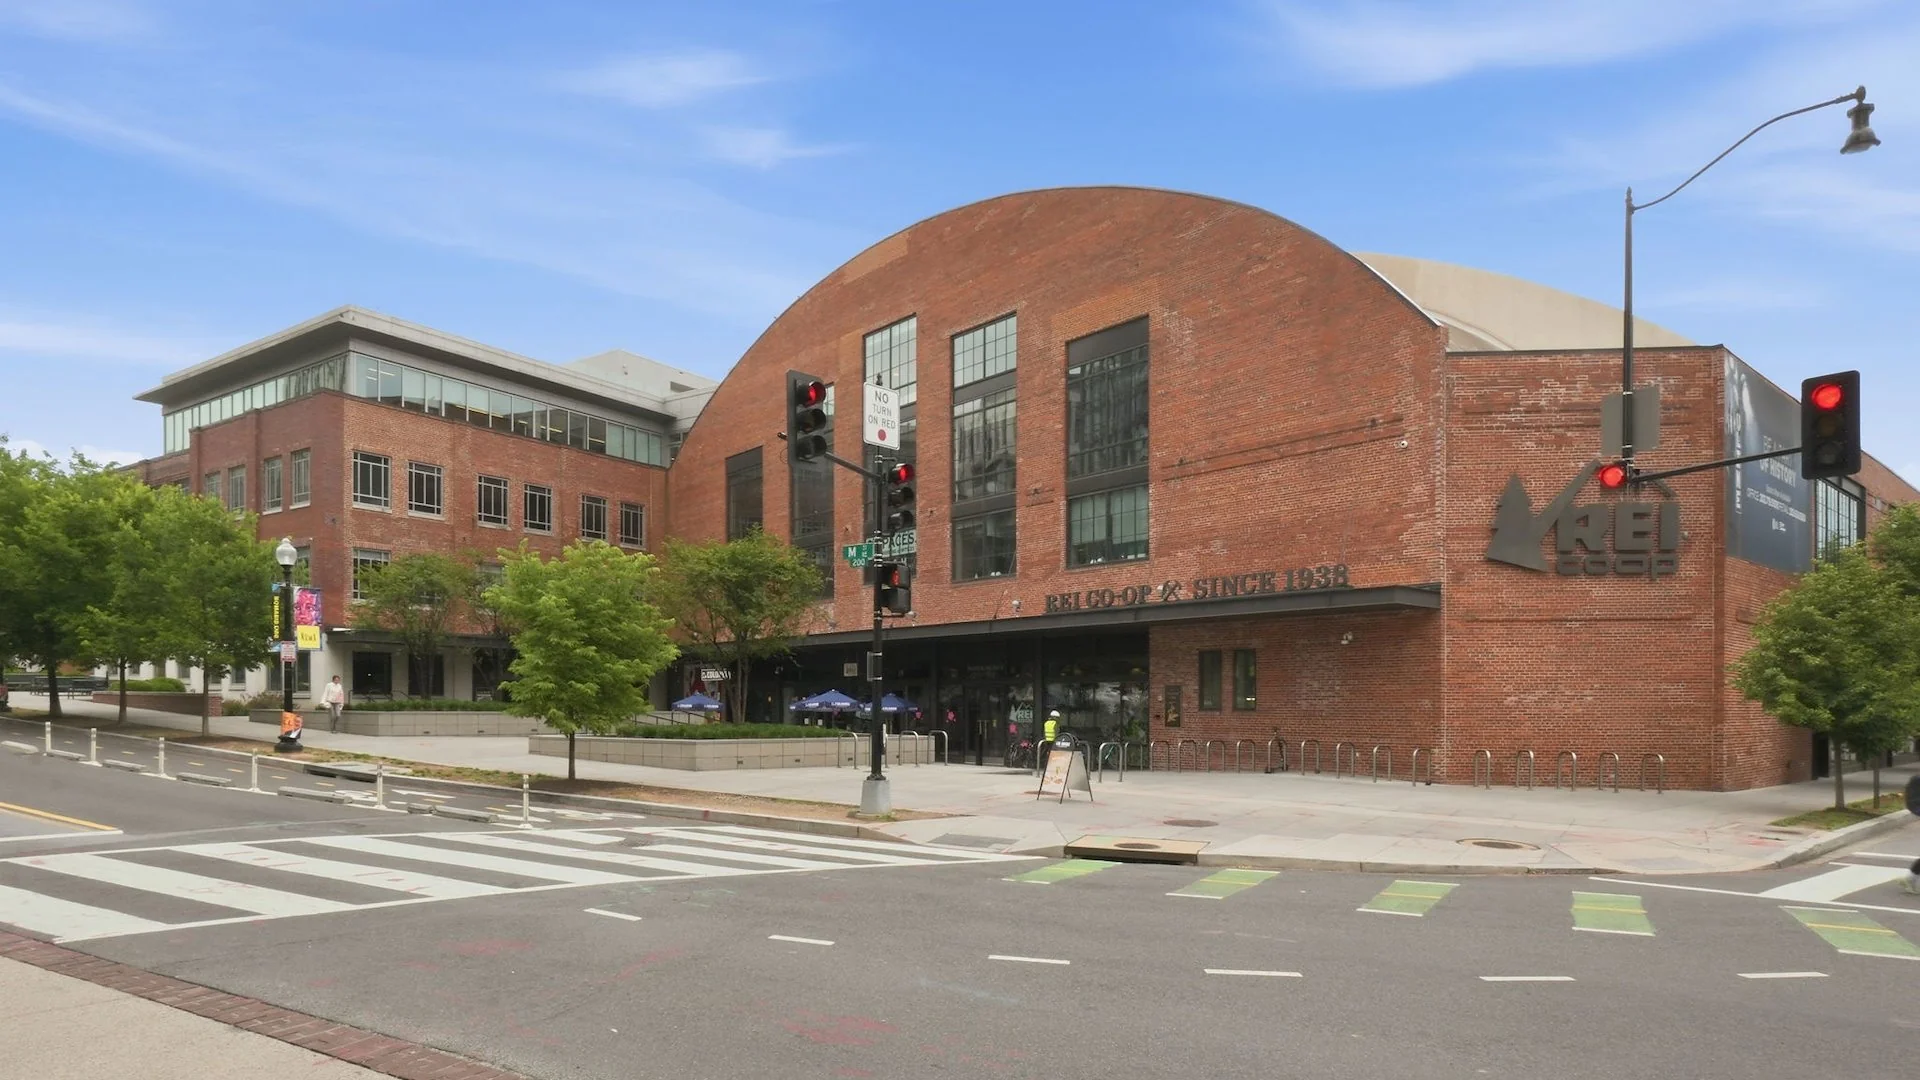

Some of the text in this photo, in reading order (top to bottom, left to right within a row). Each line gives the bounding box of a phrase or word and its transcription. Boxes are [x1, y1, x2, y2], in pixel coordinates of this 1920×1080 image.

[874, 390, 889, 404] NO
[872, 403, 892, 417] TURN
[868, 414, 896, 429] ON RED
[1760, 457, 1797, 488] OF HISTORY
[1556, 502, 1680, 552] REI
[848, 546, 857, 558] M
[852, 559, 866, 567] 200
[1045, 563, 1349, 613] REI CO-OP SINCE 1938
[1018, 709, 1033, 719] REI
